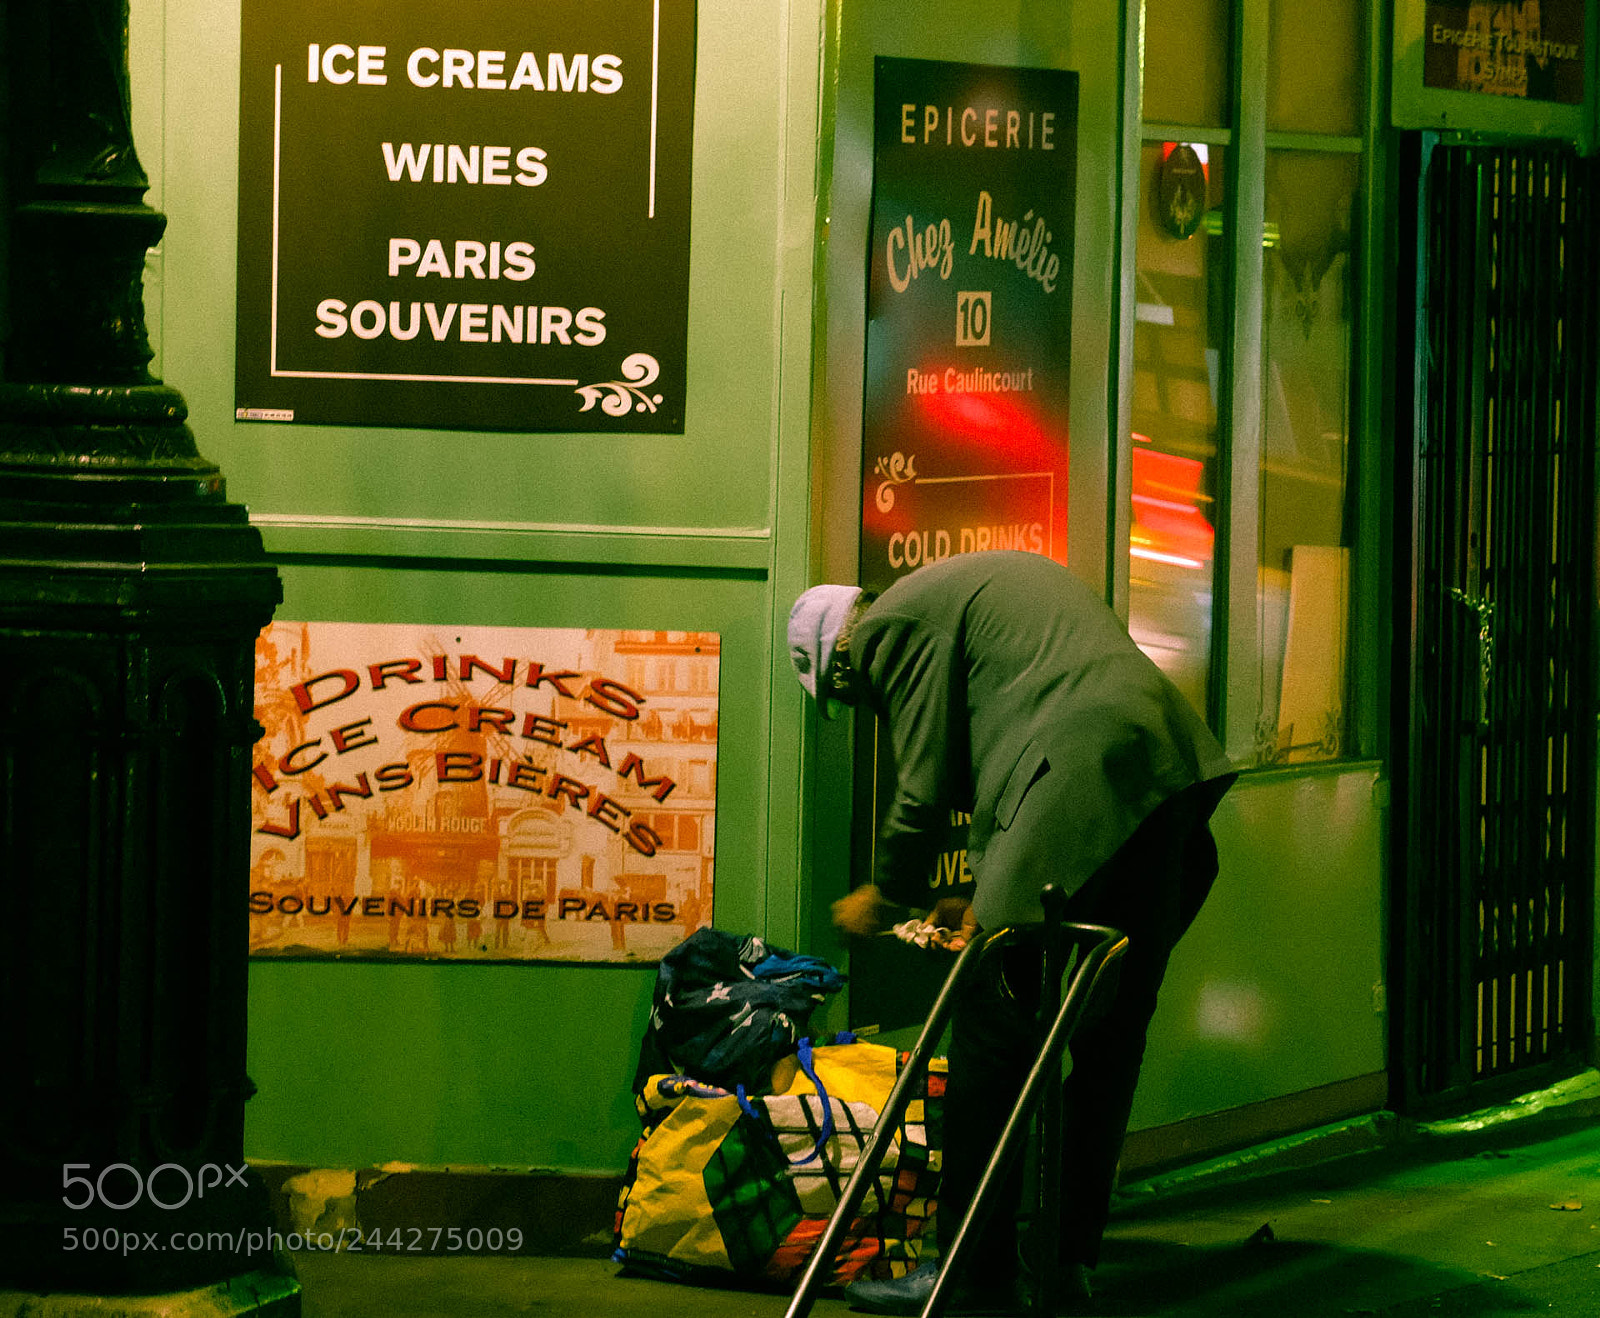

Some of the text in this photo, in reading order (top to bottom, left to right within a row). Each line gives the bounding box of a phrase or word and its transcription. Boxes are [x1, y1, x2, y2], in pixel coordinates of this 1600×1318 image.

[308, 43, 624, 95] ICE CREAMS
[901, 103, 1055, 150] EPICERIE
[382, 142, 548, 187] WINES
[388, 238, 536, 281] PARIS
[886, 190, 1060, 294] Chez Amélie
[314, 299, 607, 346] SOUVENIRS
[959, 298, 988, 342] 10
[907, 367, 1033, 394] Rue Caulincourt
[888, 522, 1043, 568] COLD DRINKS
[290, 654, 647, 721] DRINKS
[253, 702, 677, 805] ICE CREAM
[258, 751, 664, 858] VINS BIÈRES
[249, 891, 677, 922] SOUVENIRS DE PARIS
